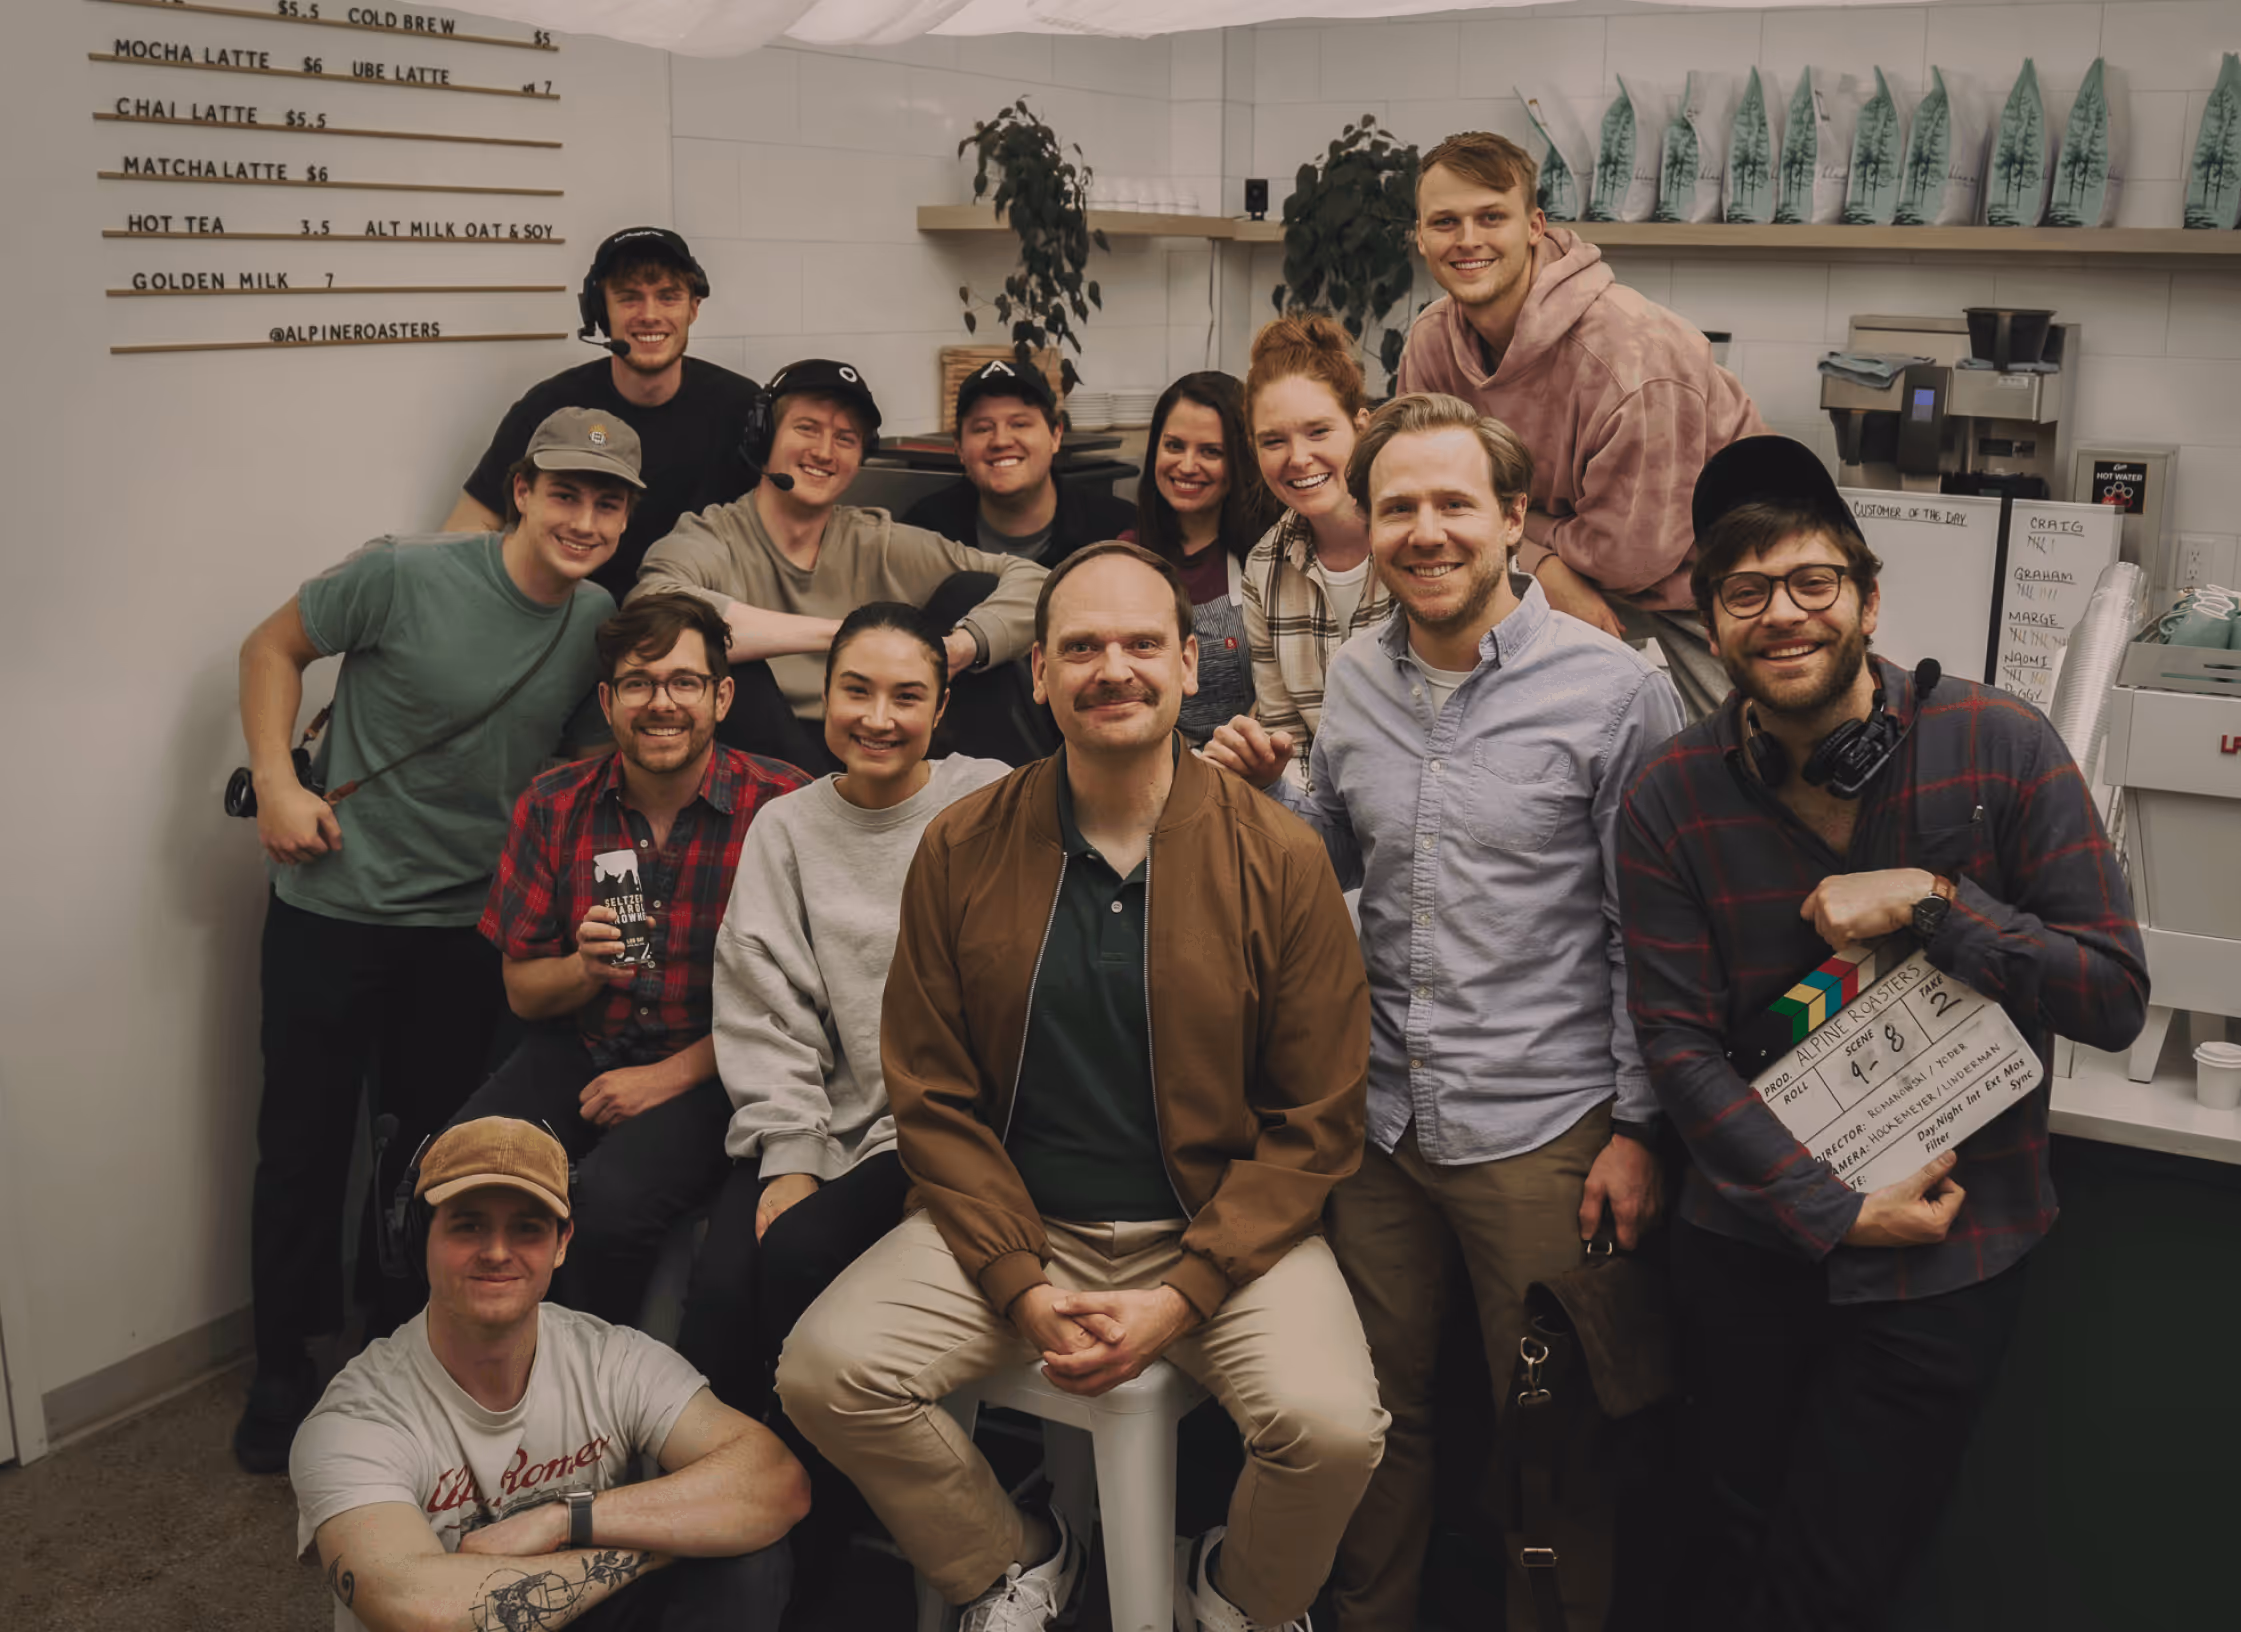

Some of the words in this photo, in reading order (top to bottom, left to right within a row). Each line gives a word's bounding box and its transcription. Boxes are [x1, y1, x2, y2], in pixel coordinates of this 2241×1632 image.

[278, 0, 319, 19] $5.5
[348, 8, 397, 27] COLD
[403, 14, 455, 34] BREW
[534, 30, 550, 48] $5
[115, 39, 193, 62] MOCHA
[205, 47, 270, 69] LATTE
[303, 56, 322, 74] $6
[353, 61, 385, 79] UBE
[396, 65, 449, 85] LATTE
[116, 98, 175, 118] CHAI
[193, 103, 257, 124] LATTE
[285, 110, 326, 128] $5.5
[307, 165, 328, 182] $6
[128, 214, 173, 232] HOT
[185, 216, 224, 234] TEA
[300, 220, 330, 236] 3.5
[365, 220, 400, 237] ALT
[410, 222, 455, 238] MILK
[465, 222, 501, 239] OAT
[509, 223, 518, 239] &
[524, 224, 553, 240] SOY
[132, 273, 225, 290] GOLDEN
[239, 273, 288, 289] MILK
[325, 272, 334, 289] 7
[269, 322, 440, 342] @ALPINEROASTERS
[2096, 472, 2113, 480] HOT
[2115, 473, 2143, 482] WATER
[1854, 501, 1901, 517] CUSTOMER
[1908, 507, 1919, 518] OF
[1923, 508, 1941, 521] THE
[1945, 511, 1967, 526] DAY
[2030, 516, 2084, 533] CRAIG
[2014, 567, 2073, 582] GRAHAM
[2009, 611, 2059, 626] MARGE
[2004, 652, 2048, 667] NAOMI
[1918, 974, 1945, 998] TAKE
[1930, 991, 1962, 1018] 2
[1764, 1072, 1793, 1097] PROD.
[1796, 1018, 1849, 1067] ALPINE
[1847, 964, 1921, 1023] ROASTERS
[1844, 1029, 1875, 1057] SCENE
[1783, 1081, 1809, 1105] ROLL
[1967, 1090, 1981, 1106] Int
[1984, 1075, 2001, 1092] Ext
[2003, 1058, 2025, 1078] Mos
[1925, 1131, 1950, 1154] Filter
[2010, 1069, 2034, 1092] Sync
